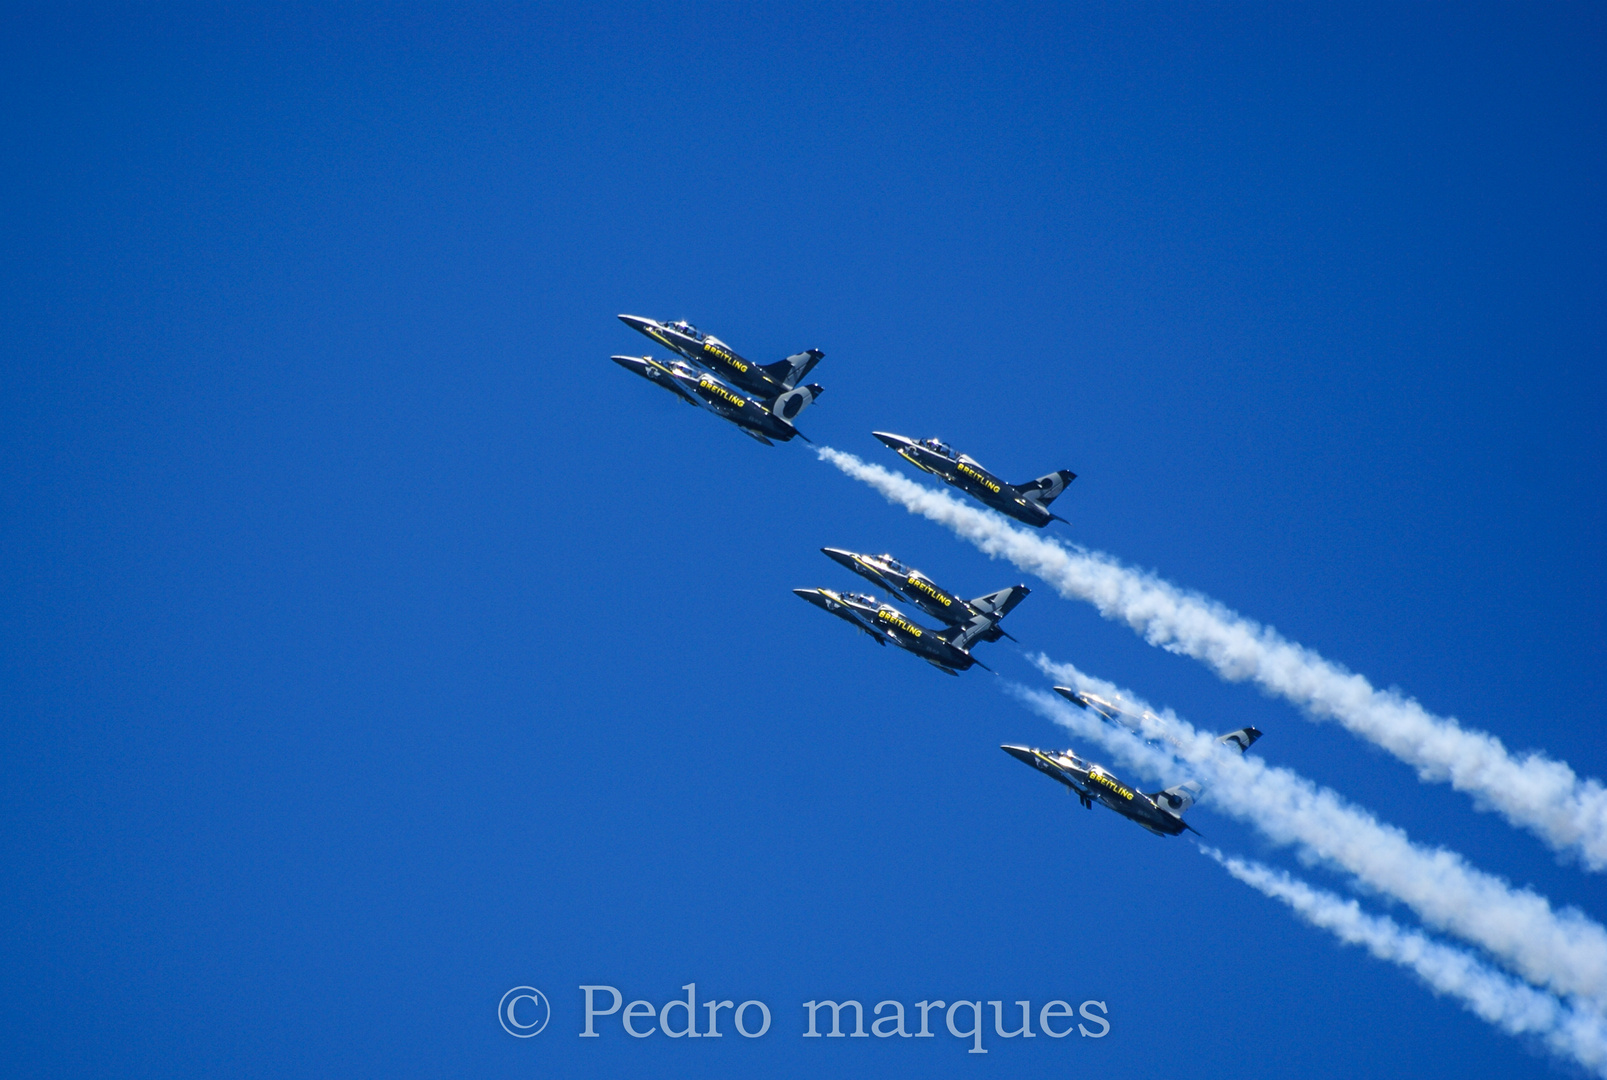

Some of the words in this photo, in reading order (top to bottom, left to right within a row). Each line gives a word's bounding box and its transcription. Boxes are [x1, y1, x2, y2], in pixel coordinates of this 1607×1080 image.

[704, 343, 748, 373] BREITLING
[700, 379, 745, 408] BREITLING
[957, 462, 1000, 493] BREITLING
[1022, 472, 1064, 515] 2
[907, 576, 952, 607] BREITLING
[878, 609, 922, 638] BREITLING
[1089, 771, 1134, 802] BREITLING
